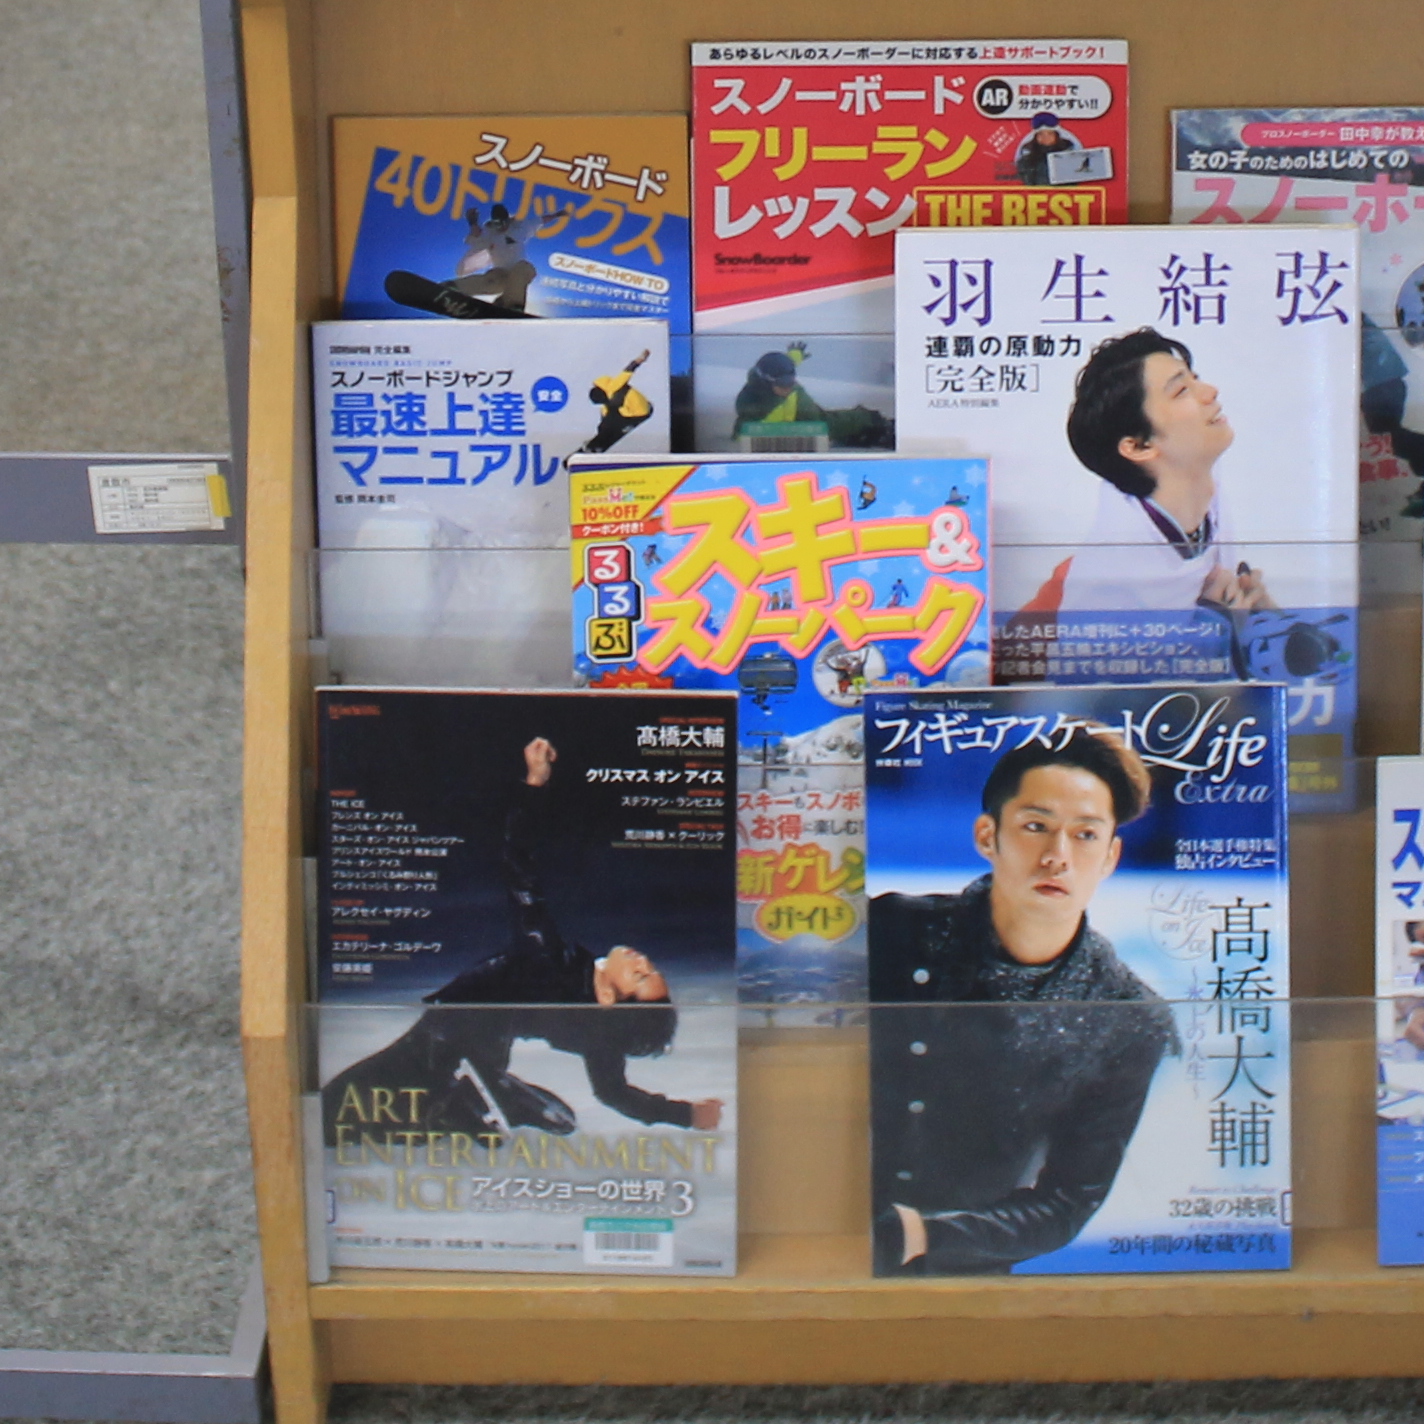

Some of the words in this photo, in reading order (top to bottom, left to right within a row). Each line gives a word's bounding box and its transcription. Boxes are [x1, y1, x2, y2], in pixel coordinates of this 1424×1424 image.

[710, 74, 966, 116] スノーボード
[980, 87, 1009, 107] AR
[1018, 97, 1099, 111] 分かりやすい!!
[709, 125, 977, 182] フリーラン
[1187, 148, 1409, 171] 女の子のためのはじめての
[474, 132, 669, 203] スノーボード
[374, 151, 665, 267] 40トリックス
[714, 185, 918, 240] レッスン
[924, 194, 985, 226] THE
[1003, 193, 1095, 226] BEST
[714, 252, 812, 268] SnowBoarder
[644, 276, 666, 292] TO
[923, 250, 1351, 327] 羽生結弦
[924, 335, 1082, 358] 連覇の原動力
[331, 369, 514, 388] スノーボードジャンプ
[537, 389, 563, 402] 安全
[330, 392, 526, 439] 最速上達
[333, 443, 559, 488] マニュアル
[581, 504, 640, 521] 10%OFF
[582, 522, 645, 536] クーポン付き!
[659, 475, 974, 603] スキー&
[587, 547, 635, 658] るるぶ
[640, 580, 978, 668] スノーパーク
[876, 699, 906, 712] Figure
[910, 699, 944, 712] Skating
[947, 698, 993, 711] Magazine
[874, 709, 1143, 754] フィギュアスケート
[1142, 692, 1268, 781] Life
[586, 768, 651, 784] クリスマス
[654, 768, 681, 784] オン
[684, 768, 725, 784] アイス
[1175, 770, 1274, 805] Extra
[331, 799, 349, 808] THE
[621, 795, 725, 809] ステファン・ランビエル
[678, 830, 725, 842] クーリック
[1176, 838, 1276, 853] 全日本選手権特集
[1176, 854, 1276, 871] 独占インタビュー
[336, 1081, 430, 1124] ART
[334, 1124, 724, 1174] ENTERTAINMENT
[393, 1169, 466, 1211] ICE
[471, 1177, 666, 1201] アイスショーの世界
[670, 1180, 694, 1218] 3
[1168, 1198, 1276, 1219] 32歳の挑戦
[1108, 1234, 1276, 1255] 20年間の秘蔵写真
